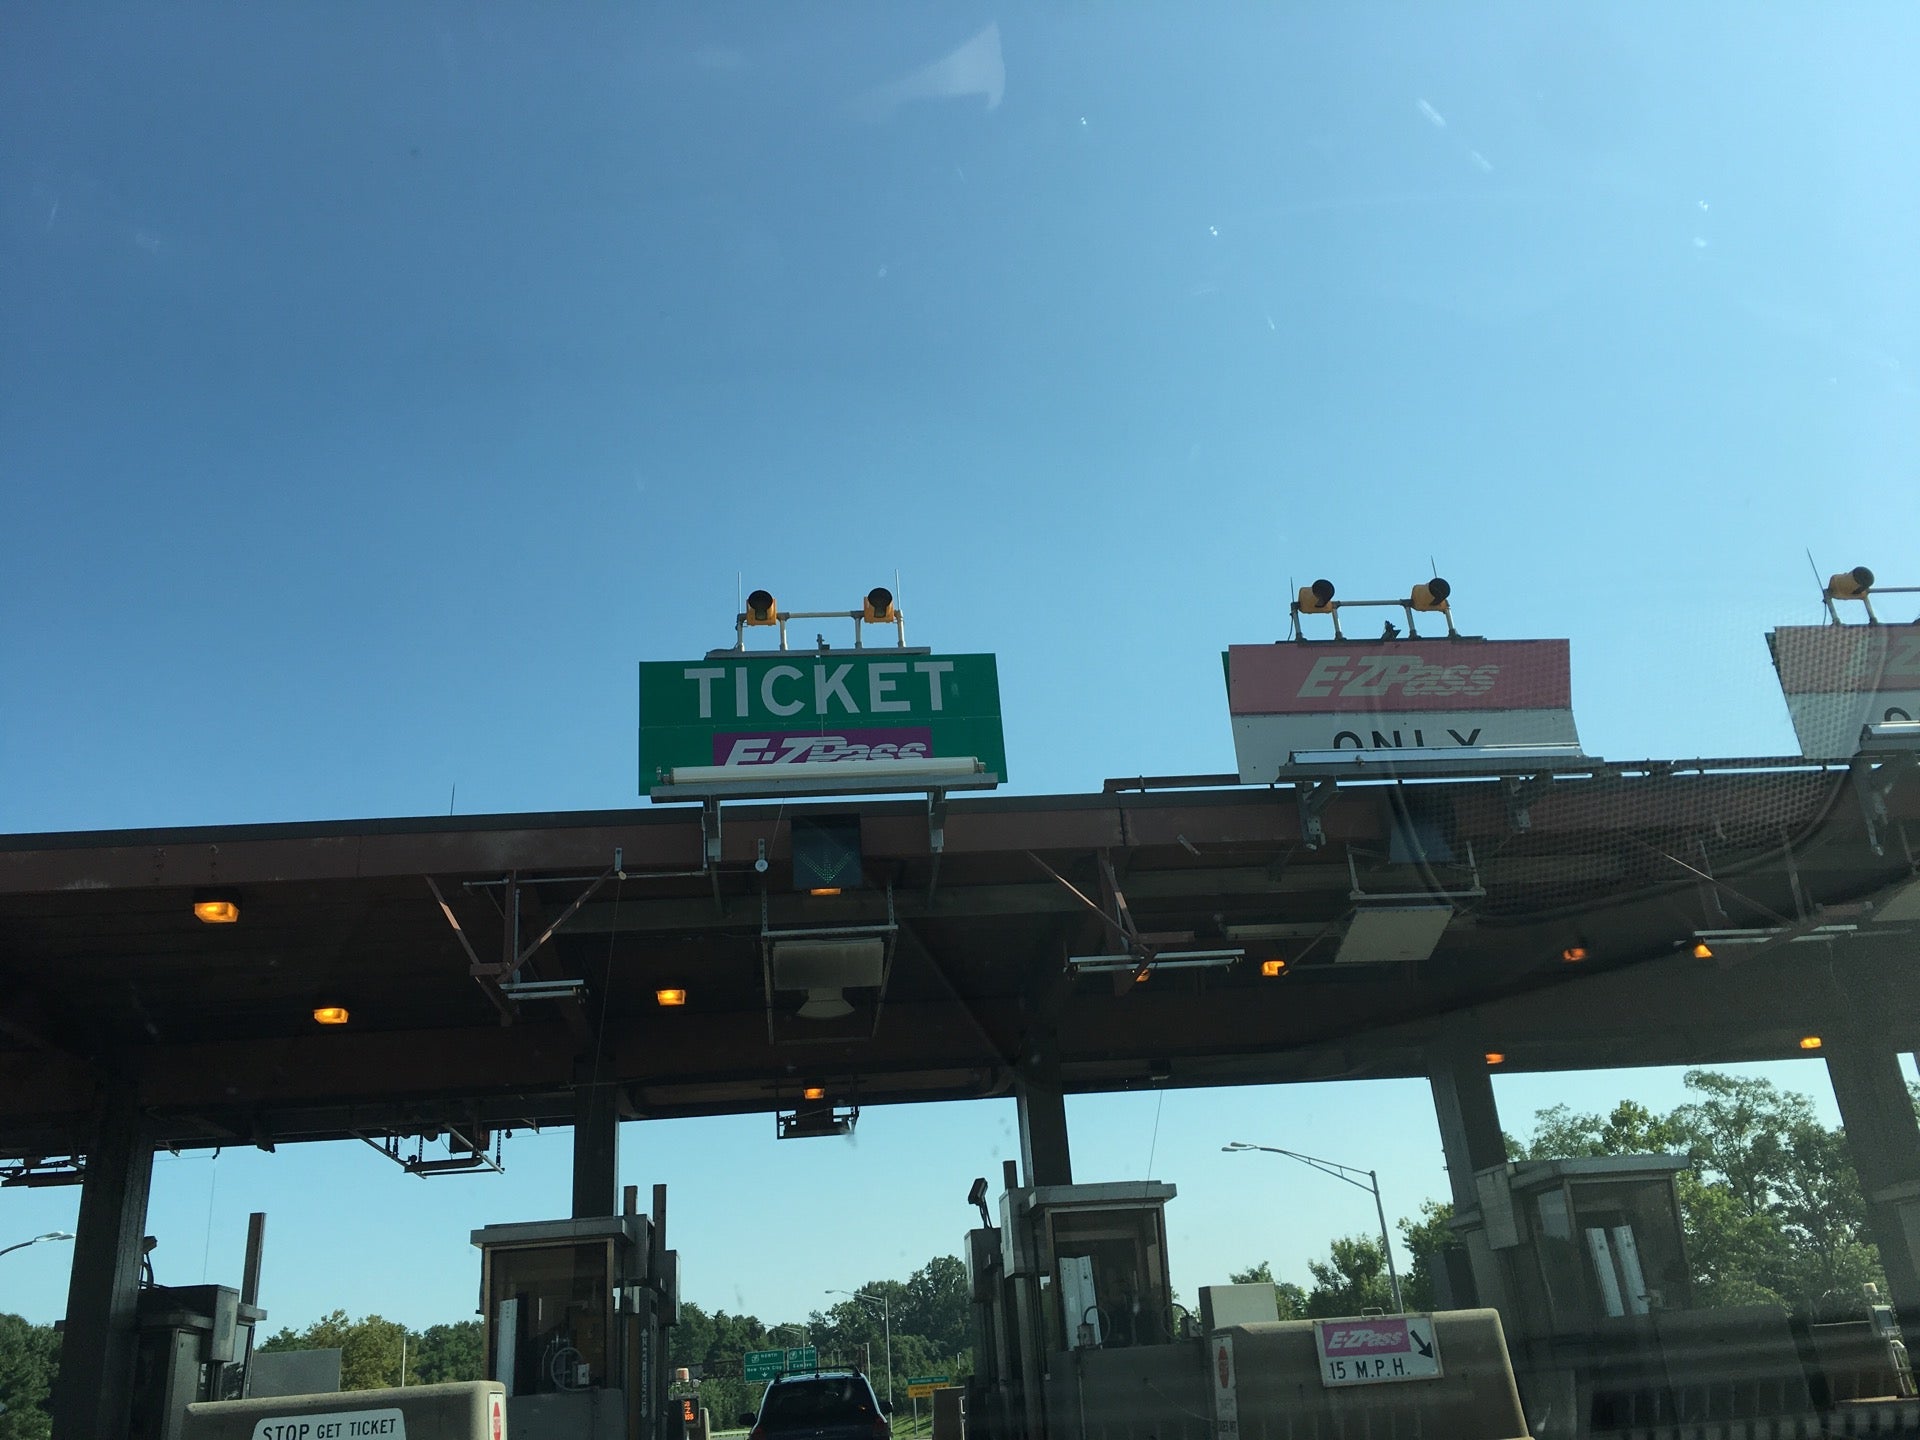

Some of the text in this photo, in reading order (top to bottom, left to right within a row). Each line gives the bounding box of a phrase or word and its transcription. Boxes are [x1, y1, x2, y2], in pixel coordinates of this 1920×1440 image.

[684, 661, 954, 718] TICKET
[1329, 1361, 1347, 1380] 15
[263, 1419, 396, 1440] STOP GET TICKET
